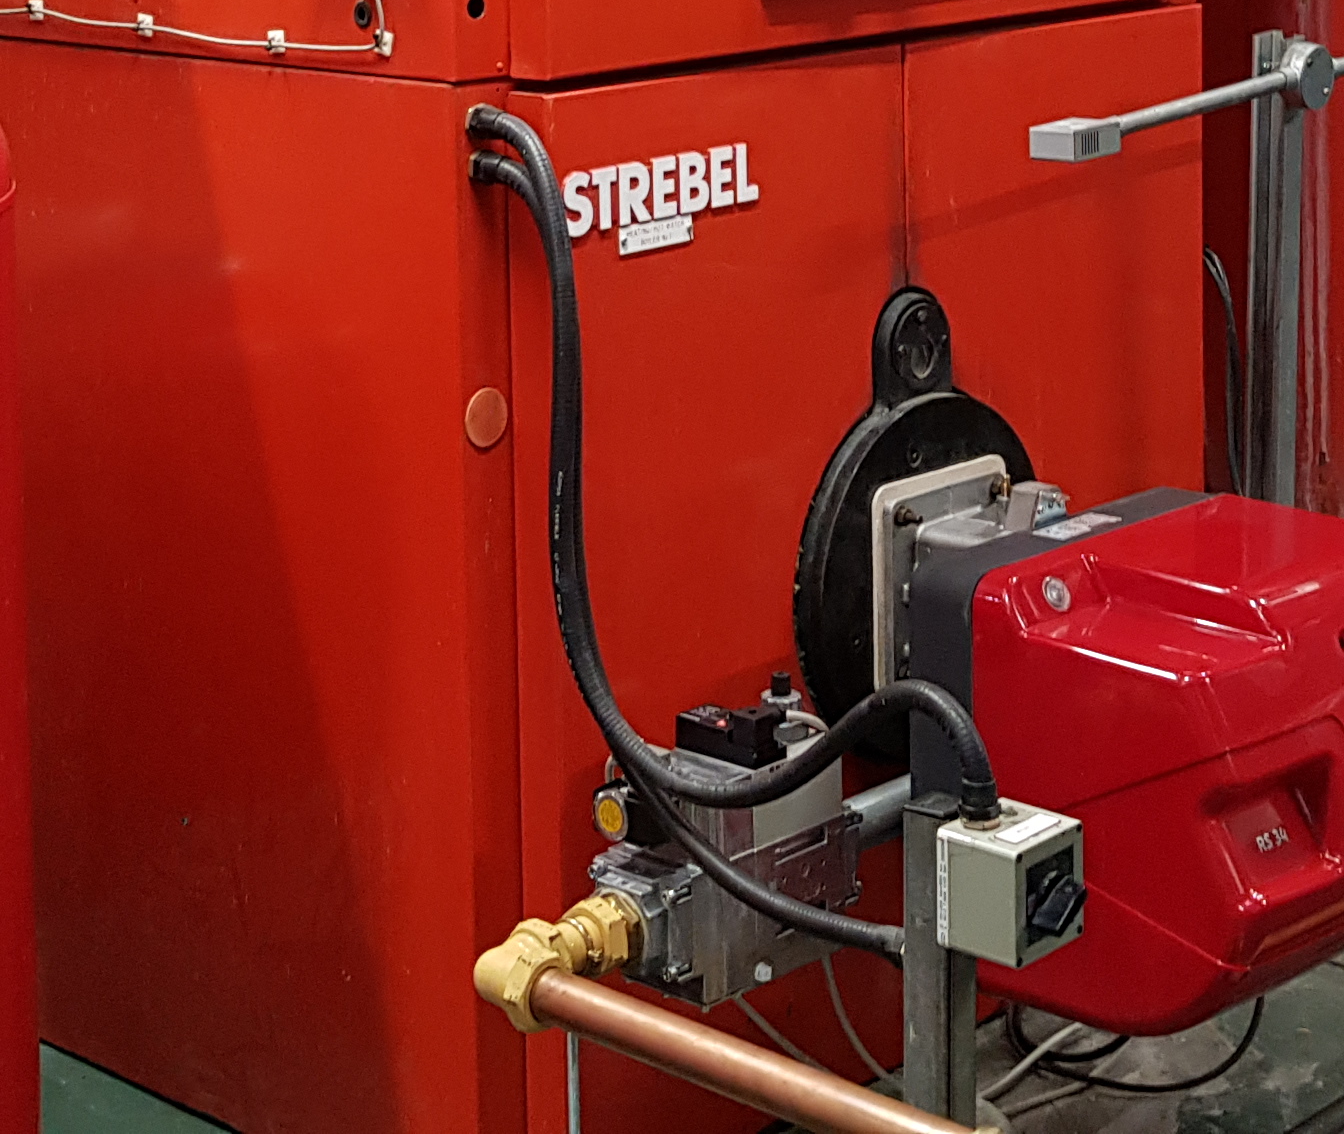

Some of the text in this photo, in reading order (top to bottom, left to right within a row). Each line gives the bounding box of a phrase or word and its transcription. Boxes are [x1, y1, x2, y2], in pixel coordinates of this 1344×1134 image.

[563, 142, 760, 238] STREBEL
[1256, 826, 1289, 853] RS 34
